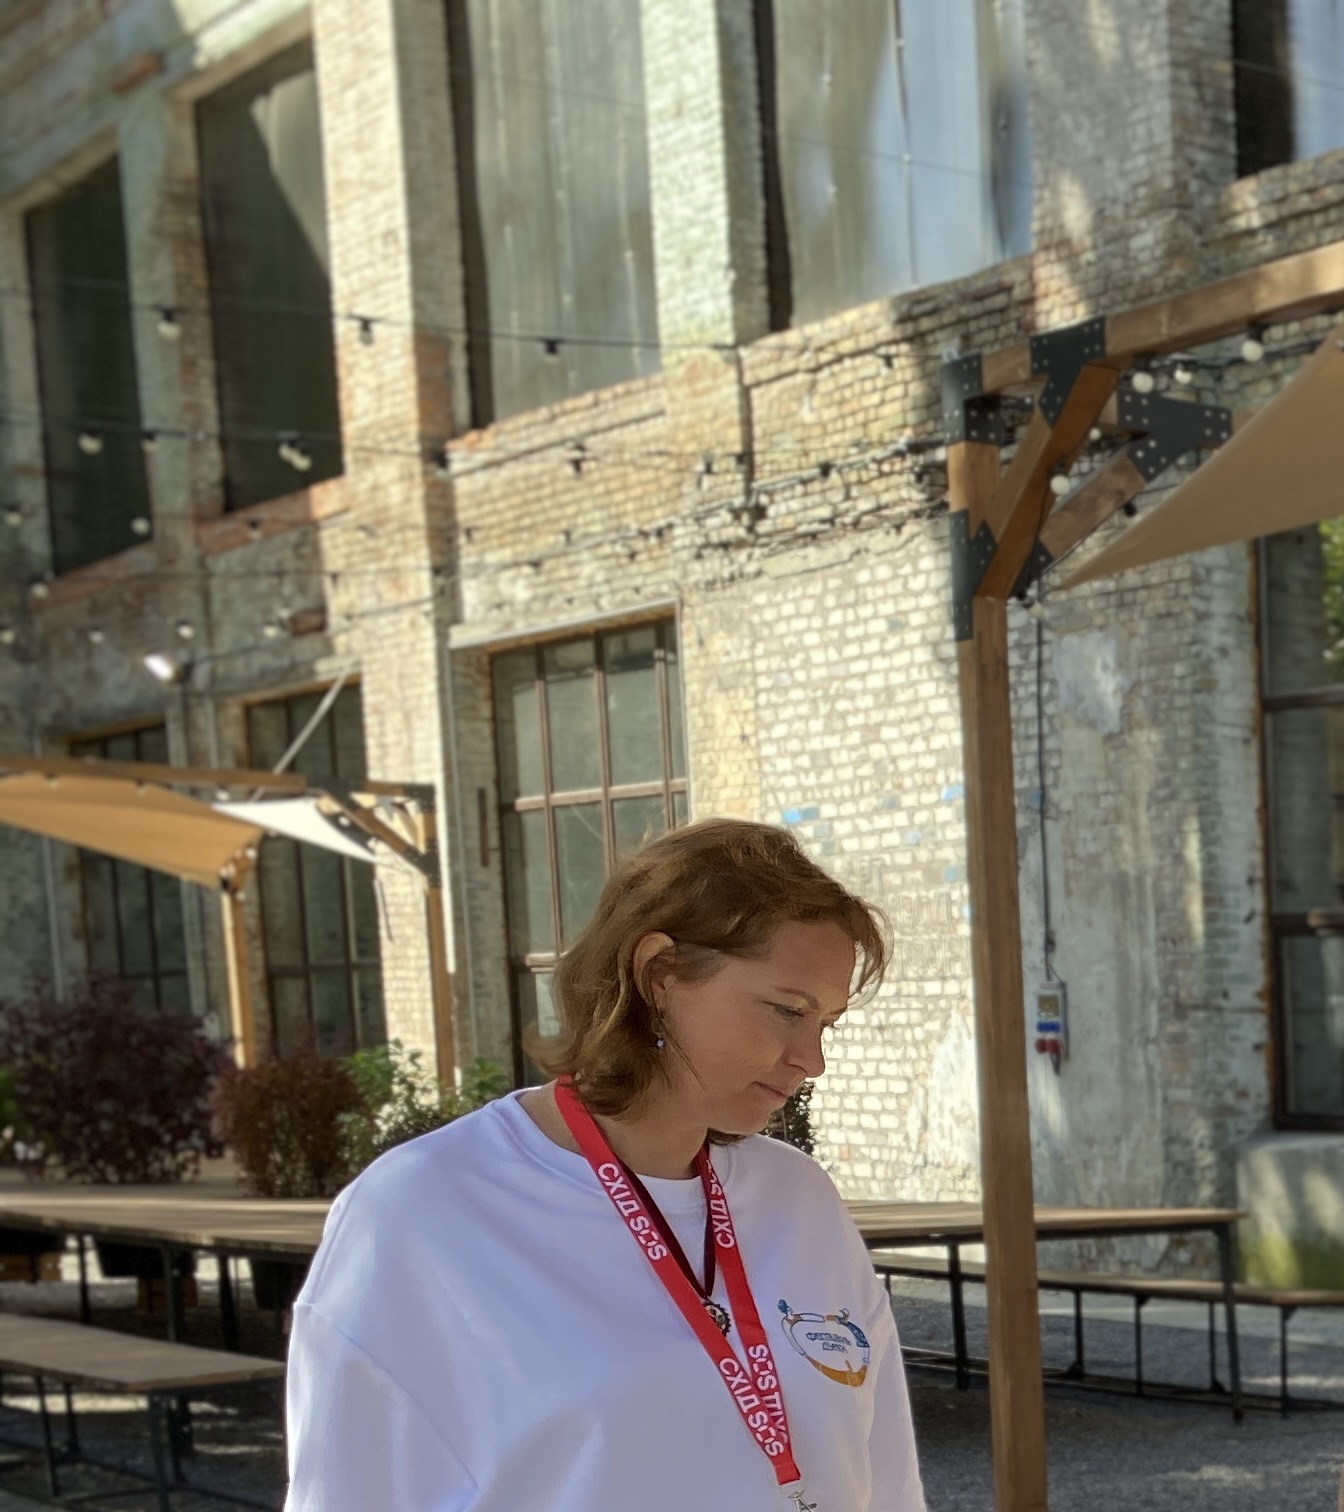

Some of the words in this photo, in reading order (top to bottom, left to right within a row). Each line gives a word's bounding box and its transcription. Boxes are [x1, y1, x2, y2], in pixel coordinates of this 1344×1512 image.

[598, 1162, 641, 1217] СХІД
[629, 1215, 667, 1261] SOS
[719, 1357, 761, 1414] СХІД
[747, 1411, 785, 1456] SOS
[747, 1344, 777, 1391] SOS
